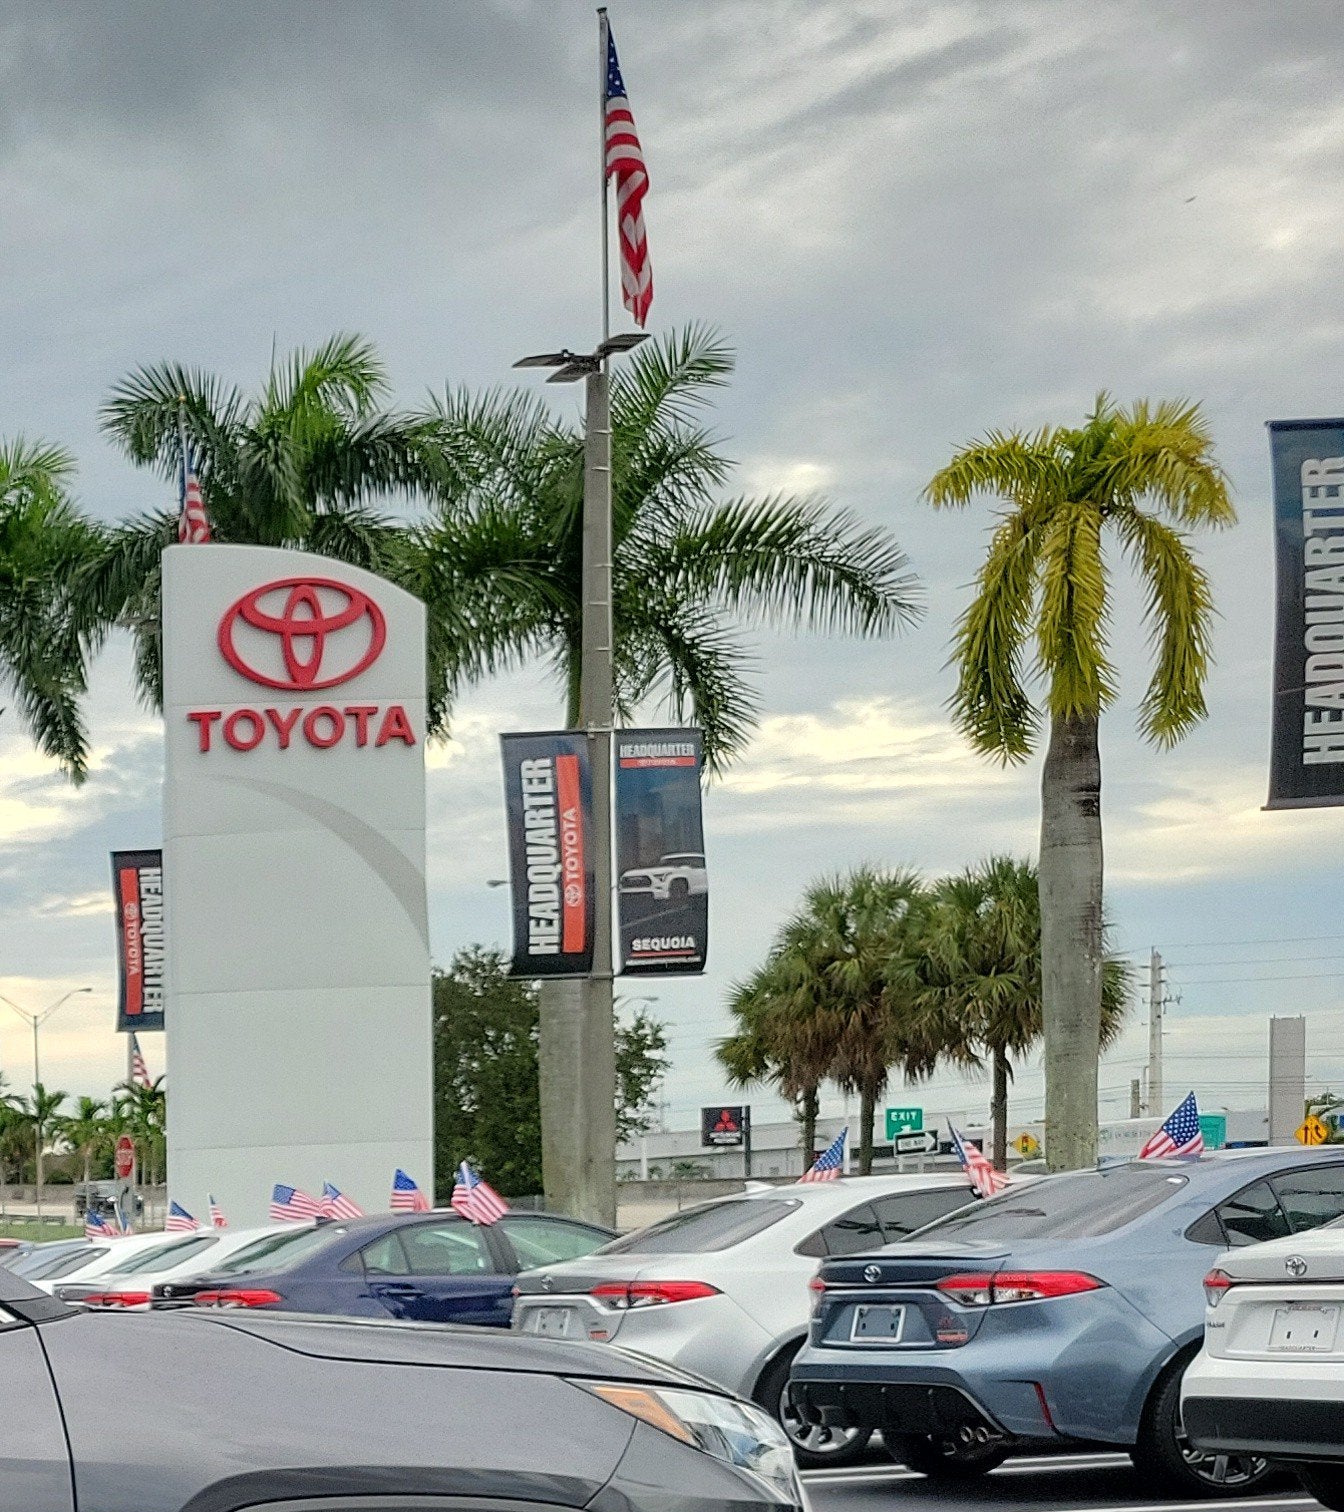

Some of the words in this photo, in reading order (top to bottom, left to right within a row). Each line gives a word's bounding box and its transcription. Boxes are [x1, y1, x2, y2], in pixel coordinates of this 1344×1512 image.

[186, 705, 417, 753] TOYOTA
[520, 757, 562, 956] HEADQUARTER
[562, 806, 581, 882] TOYOTA
[139, 867, 164, 1014] HEADQUARTER
[631, 936, 696, 952] SEQUOIA
[890, 1111, 918, 1122] EXIT
